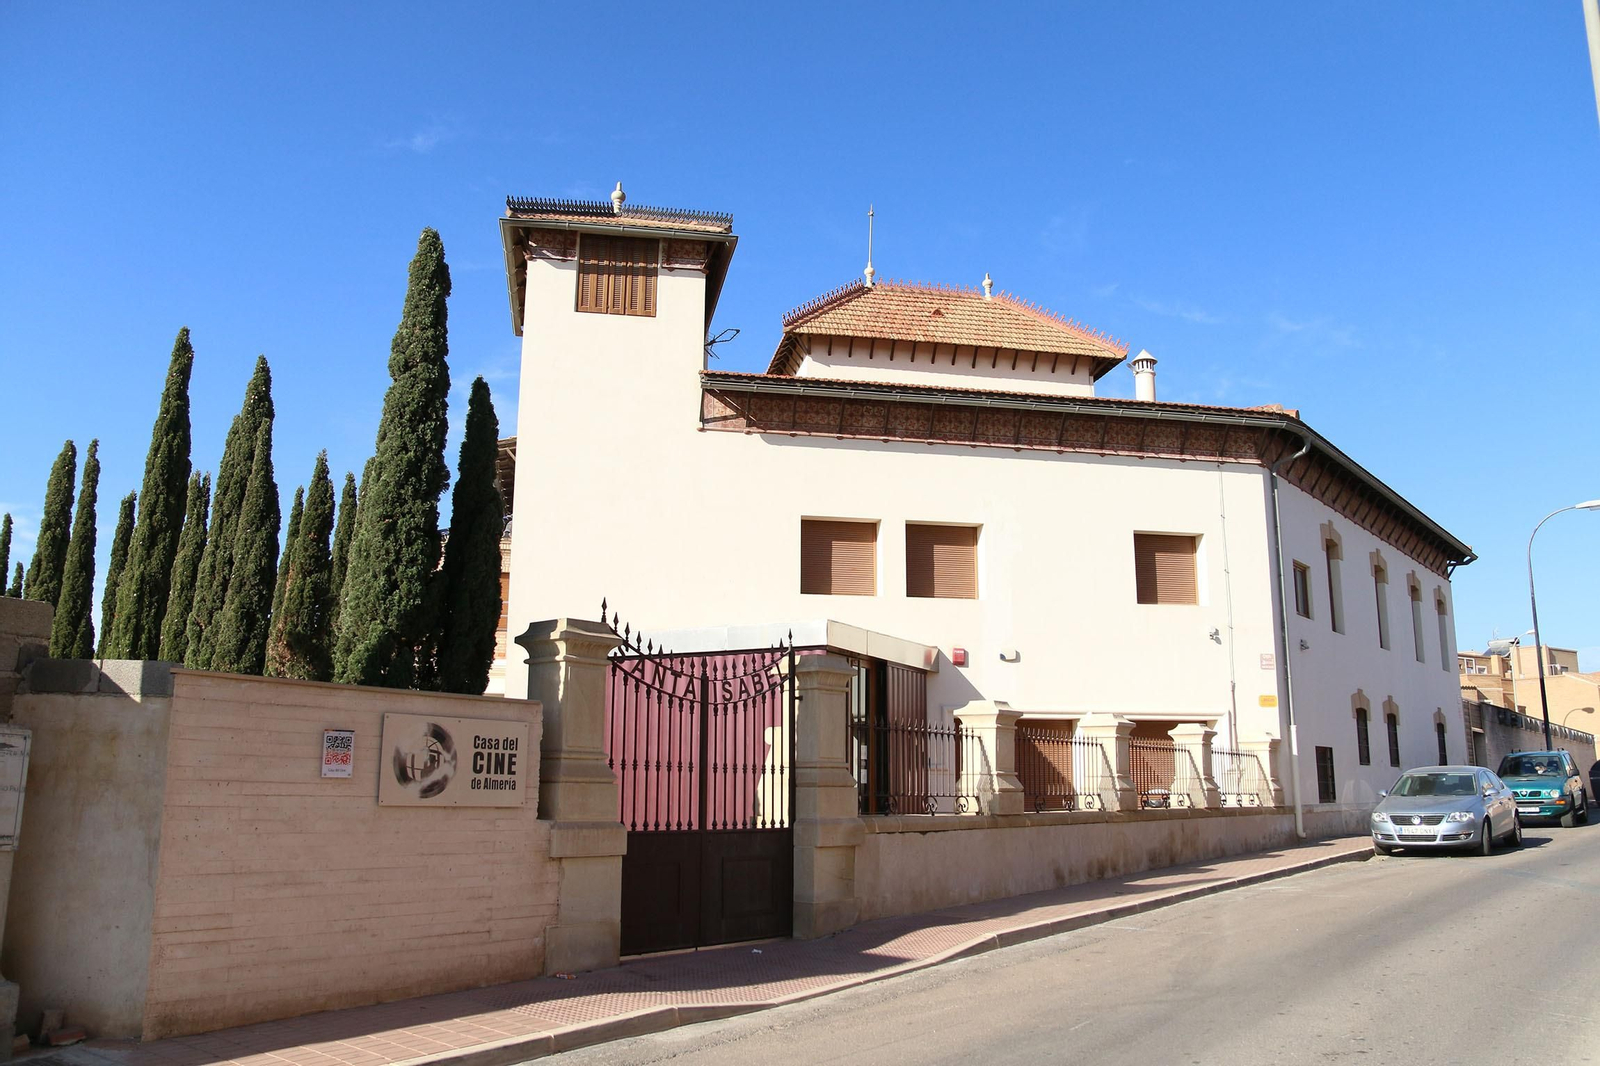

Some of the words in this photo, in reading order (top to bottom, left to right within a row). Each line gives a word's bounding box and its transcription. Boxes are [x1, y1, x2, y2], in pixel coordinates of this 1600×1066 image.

[617, 643, 697, 700] SANTA
[712, 662, 789, 702] ISABEL
[473, 735, 500, 750] Casa
[502, 737, 519, 751] del
[472, 751, 517, 776] CINE
[471, 777, 482, 790] de
[483, 777, 517, 791] Almería
